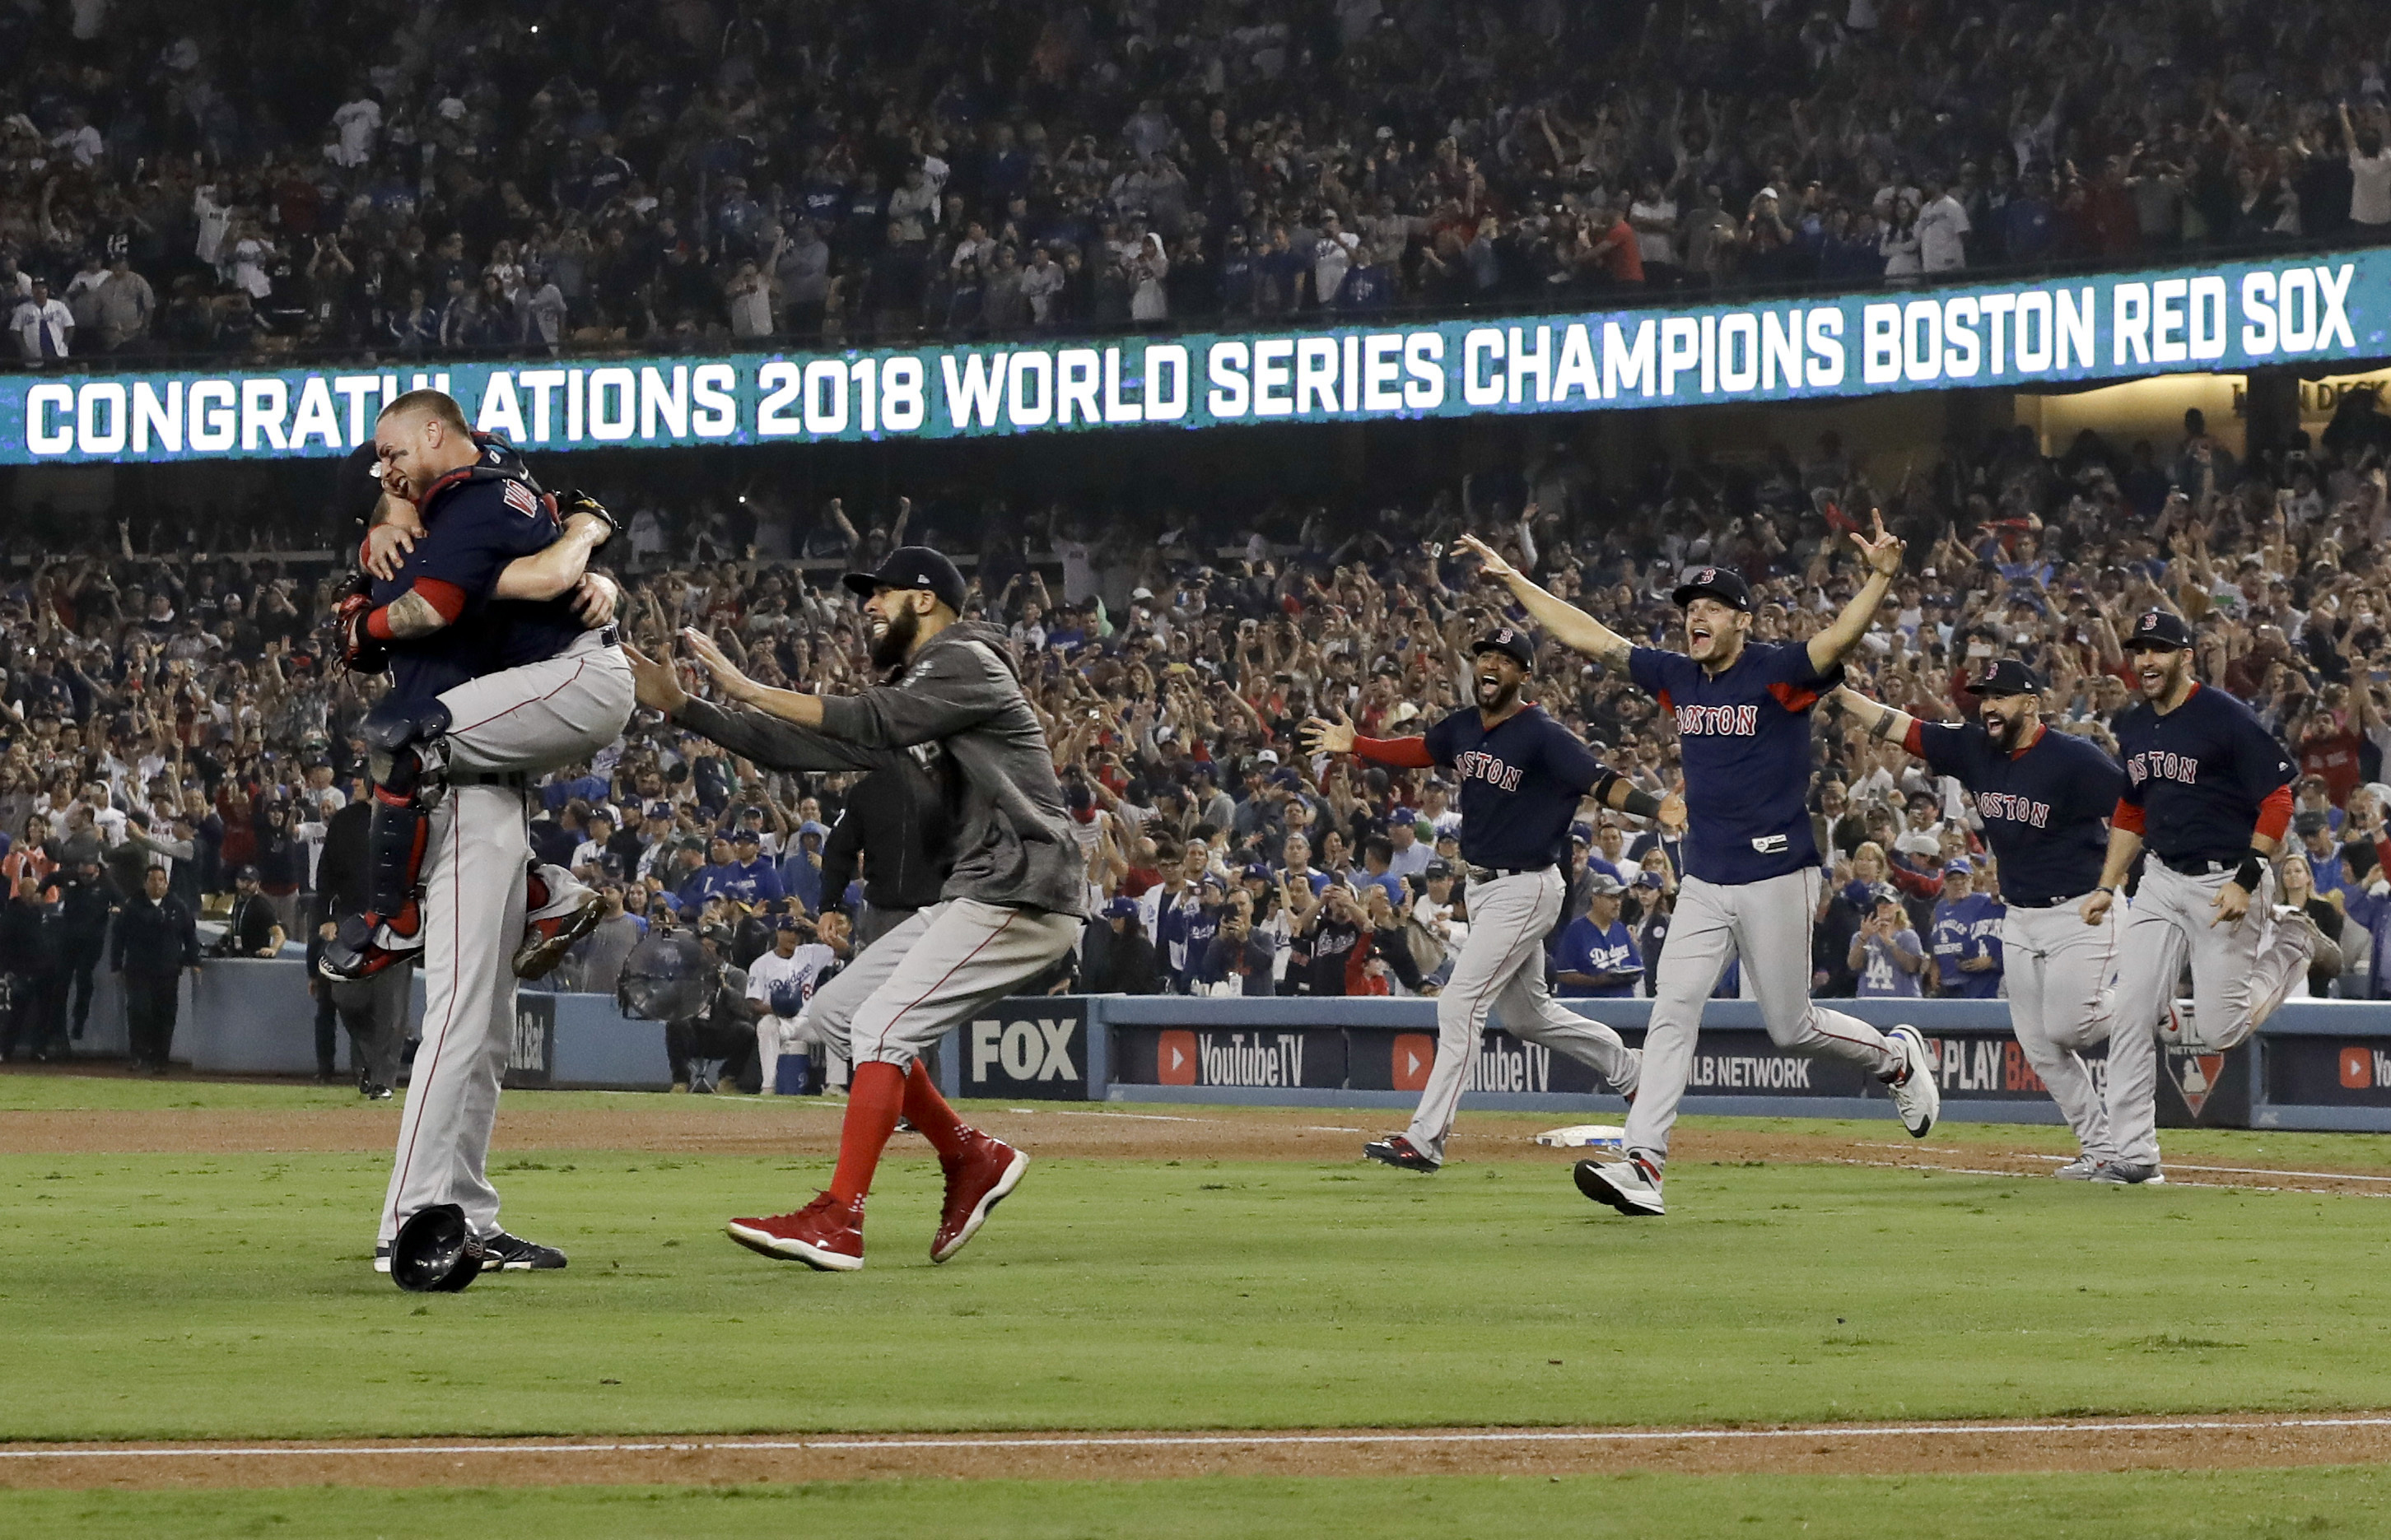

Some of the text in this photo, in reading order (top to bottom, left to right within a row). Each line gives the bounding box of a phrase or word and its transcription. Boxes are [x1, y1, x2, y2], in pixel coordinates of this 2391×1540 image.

[26, 263, 2356, 454] CONGRATATIONS 2018 WORLD SERIES CHAMPIONS BOSTON RED SOX
[1456, 751, 1523, 792] OSTON
[2127, 751, 2198, 784] OSTON
[1973, 791, 2051, 829] OSTON
[972, 1018, 1079, 1082] FOX
[2005, 1041, 2048, 1091] BA
[1718, 1057, 1813, 1089] NETWORK
